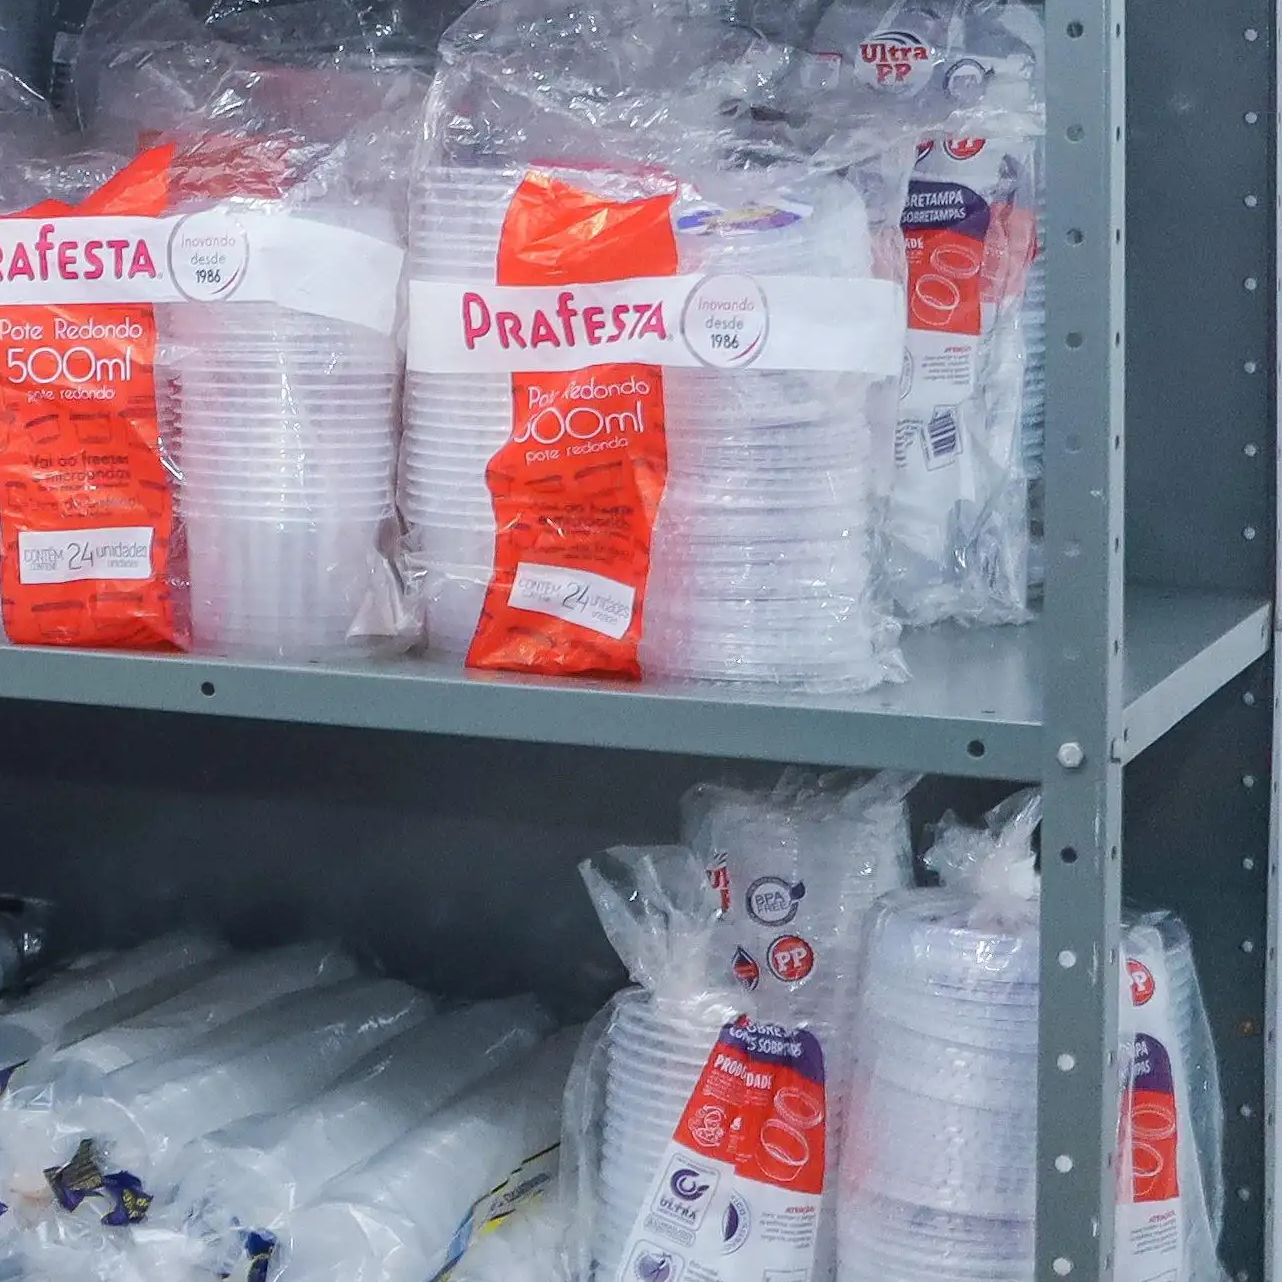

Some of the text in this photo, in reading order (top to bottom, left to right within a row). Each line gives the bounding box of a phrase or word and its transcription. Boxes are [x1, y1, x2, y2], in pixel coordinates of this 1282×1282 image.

[860, 43, 928, 63] Ultra
[875, 63, 912, 84] PP
[181, 234, 236, 248] Inovando
[191, 253, 226, 265] desde
[195, 269, 221, 284] 1986
[698, 296, 754, 313] Inovando
[54, 317, 143, 340] Redondo
[705, 316, 744, 331] desde
[711, 333, 739, 350] 1986
[6, 346, 133, 384] 500ml
[60, 385, 116, 400] redondo
[67, 542, 94, 570] 24
[96, 542, 148, 559] unidades
[562, 581, 591, 613] 24
[755, 891, 785, 906] BPA
[775, 948, 807, 971] PP
